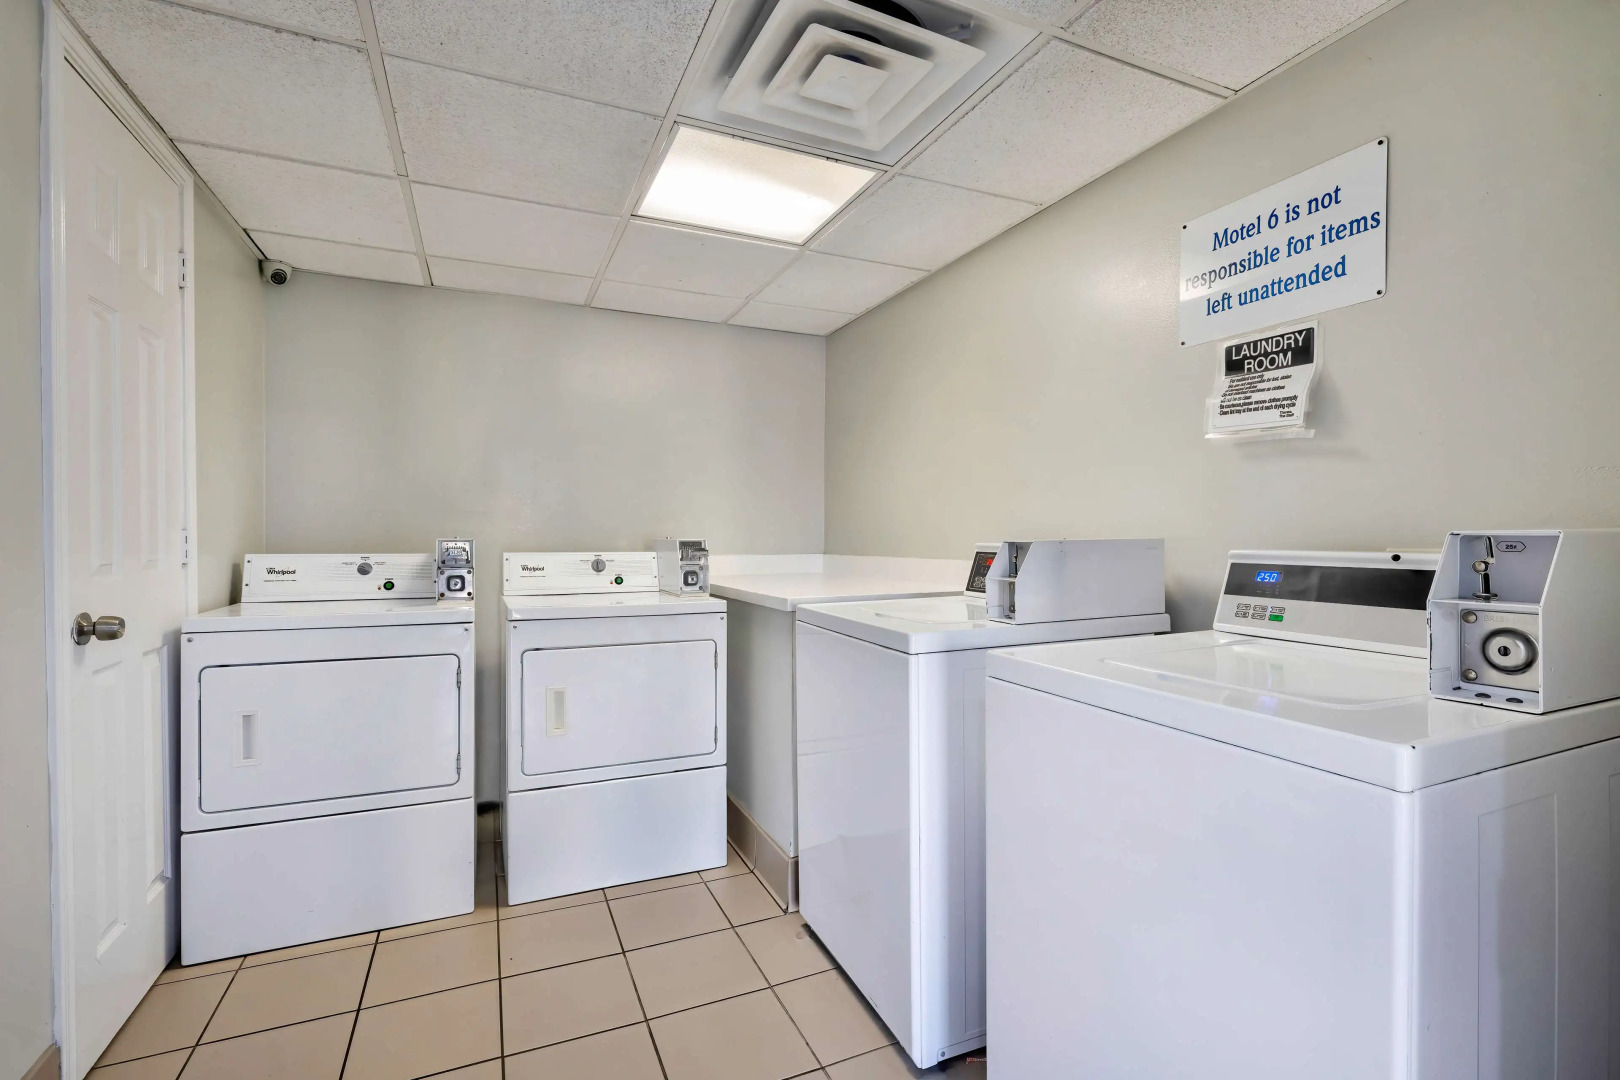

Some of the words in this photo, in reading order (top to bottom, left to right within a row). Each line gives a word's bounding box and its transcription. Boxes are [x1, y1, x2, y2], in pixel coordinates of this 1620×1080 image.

[1212, 215, 1262, 251] Motel
[1267, 208, 1279, 230] 6
[1285, 203, 1300, 224] is
[1307, 185, 1342, 215] not
[1184, 245, 1280, 293] responsible
[1286, 234, 1315, 258] for
[1320, 211, 1381, 246] items
[1206, 293, 1233, 316] left
[1238, 254, 1347, 307] unattended
[1232, 330, 1307, 360] LAUNDRY
[1244, 351, 1292, 374] ROOM
[1257, 573, 1278, 582] 250
